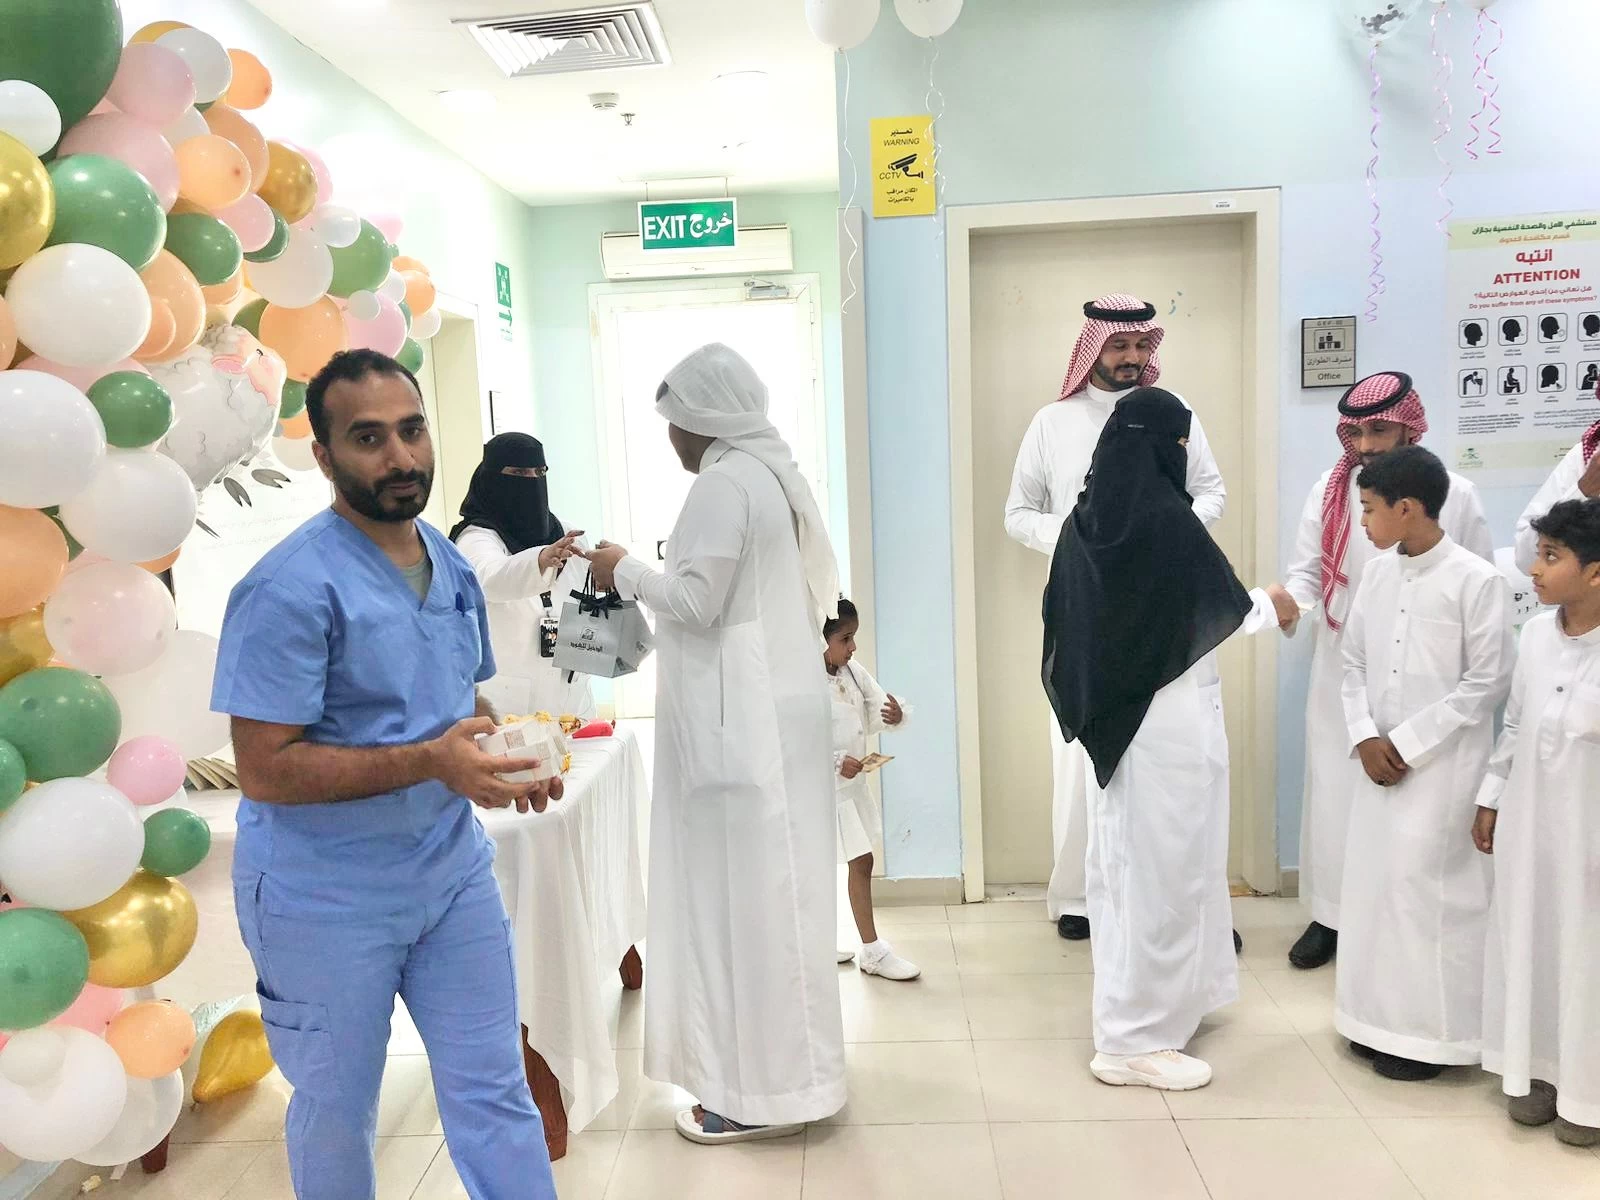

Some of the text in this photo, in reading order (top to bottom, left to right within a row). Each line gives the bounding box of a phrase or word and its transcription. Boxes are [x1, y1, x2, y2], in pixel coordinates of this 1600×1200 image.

[883, 138, 920, 147] WARNING
[879, 171, 902, 180] CCTV
[643, 214, 687, 240] EXIT
[689, 212, 733, 239] خروج
[1515, 248, 1553, 265] انتبه
[1492, 268, 1580, 285] ATTENTION
[1479, 303, 1490, 311] you
[1317, 372, 1342, 381] Office
